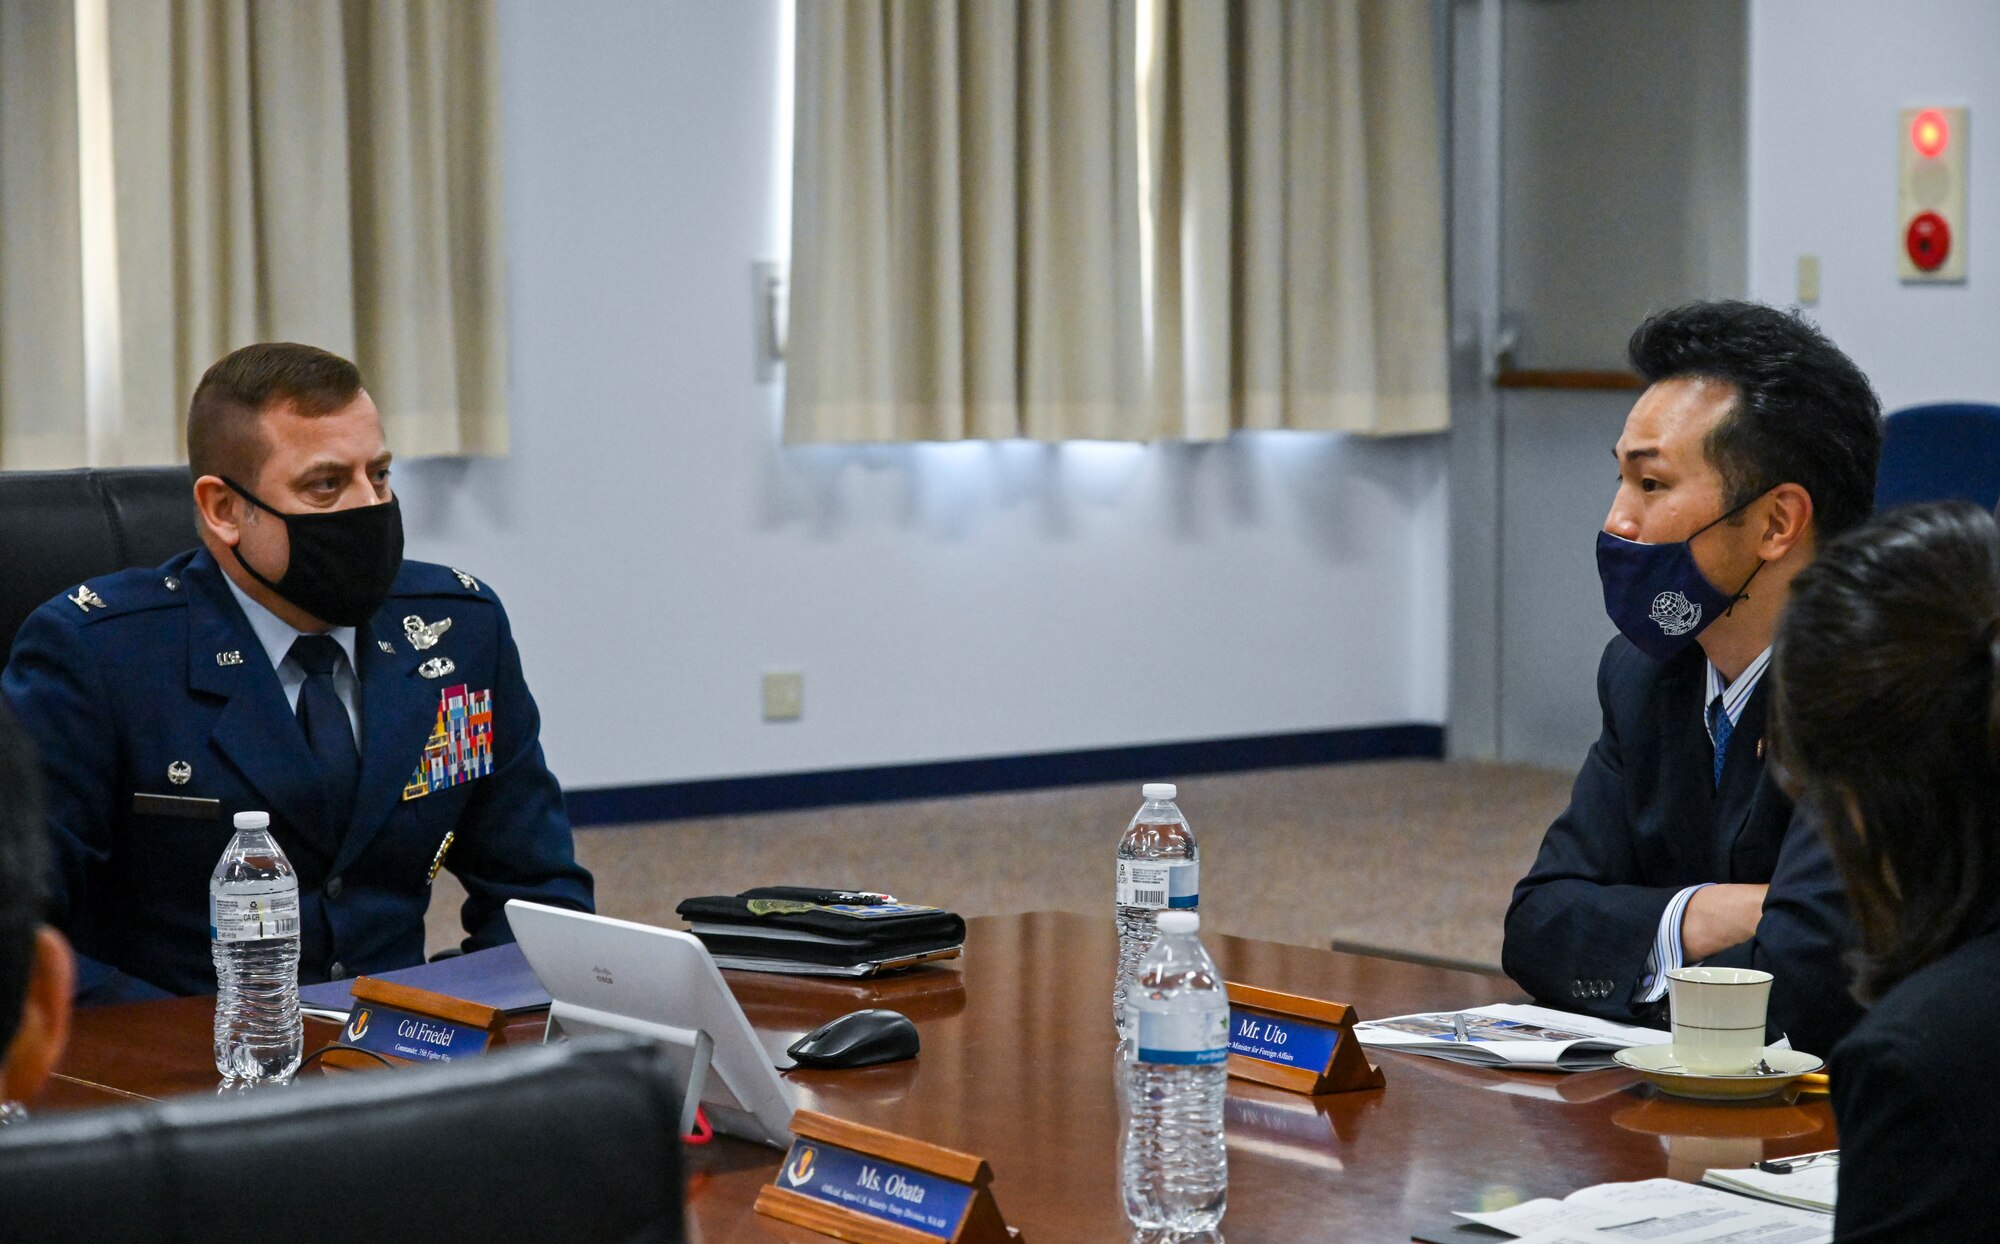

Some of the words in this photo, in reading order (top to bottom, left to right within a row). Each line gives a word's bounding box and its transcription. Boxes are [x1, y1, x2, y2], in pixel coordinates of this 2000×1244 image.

[398, 1019, 418, 1039] Col
[416, 1023, 455, 1046] Friedel
[1238, 1019, 1260, 1039] Mr.
[1264, 1024, 1287, 1045] Uto
[1232, 1041, 1251, 1052] Minister
[1251, 1045, 1259, 1054] for
[1258, 1047, 1278, 1059] Foreign
[1277, 1051, 1294, 1061] Affairs
[856, 1166, 880, 1191] Ms.
[886, 1174, 925, 1204] Obata
